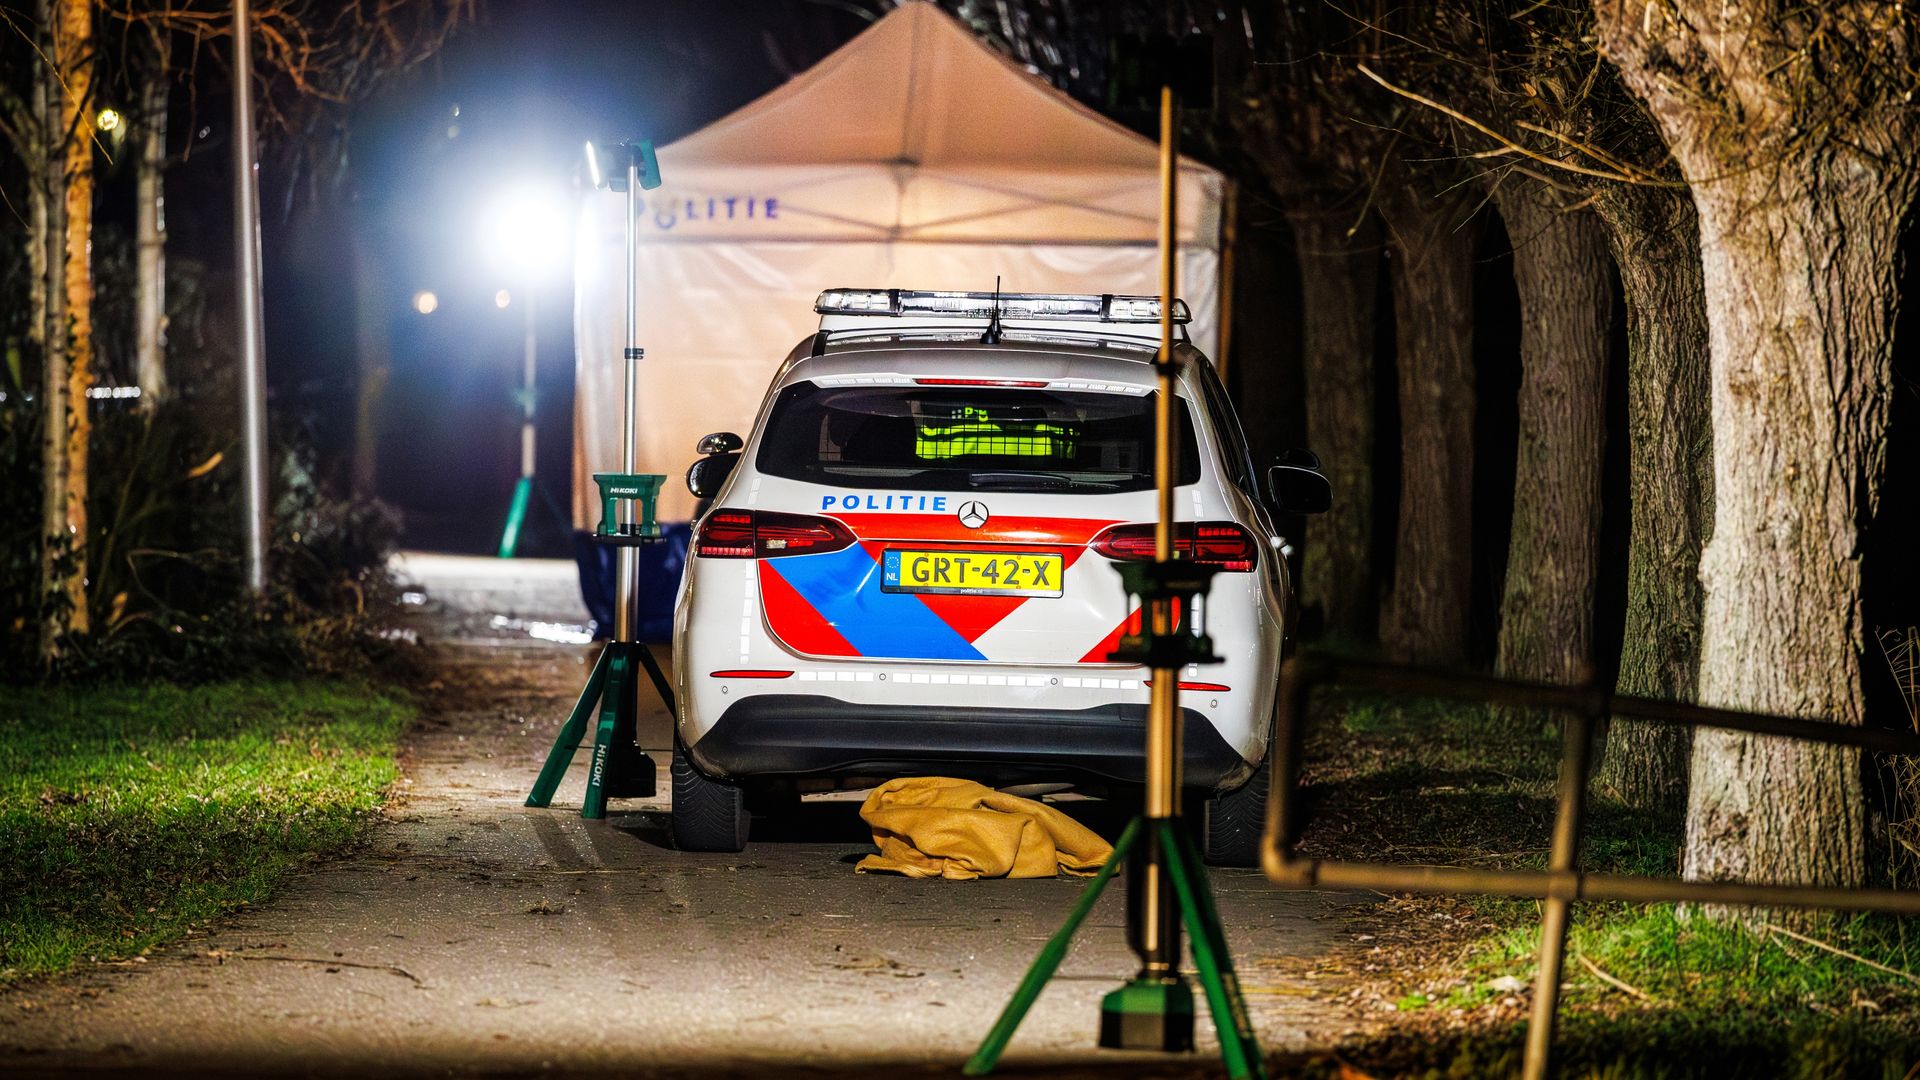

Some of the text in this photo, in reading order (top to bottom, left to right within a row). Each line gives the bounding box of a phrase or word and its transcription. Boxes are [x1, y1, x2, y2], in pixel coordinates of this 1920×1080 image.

[822, 494, 947, 511] POLITIE
[886, 572, 899, 581] NL
[912, 557, 1050, 586] GRT-42-X
[592, 743, 607, 787] HiKOKI
